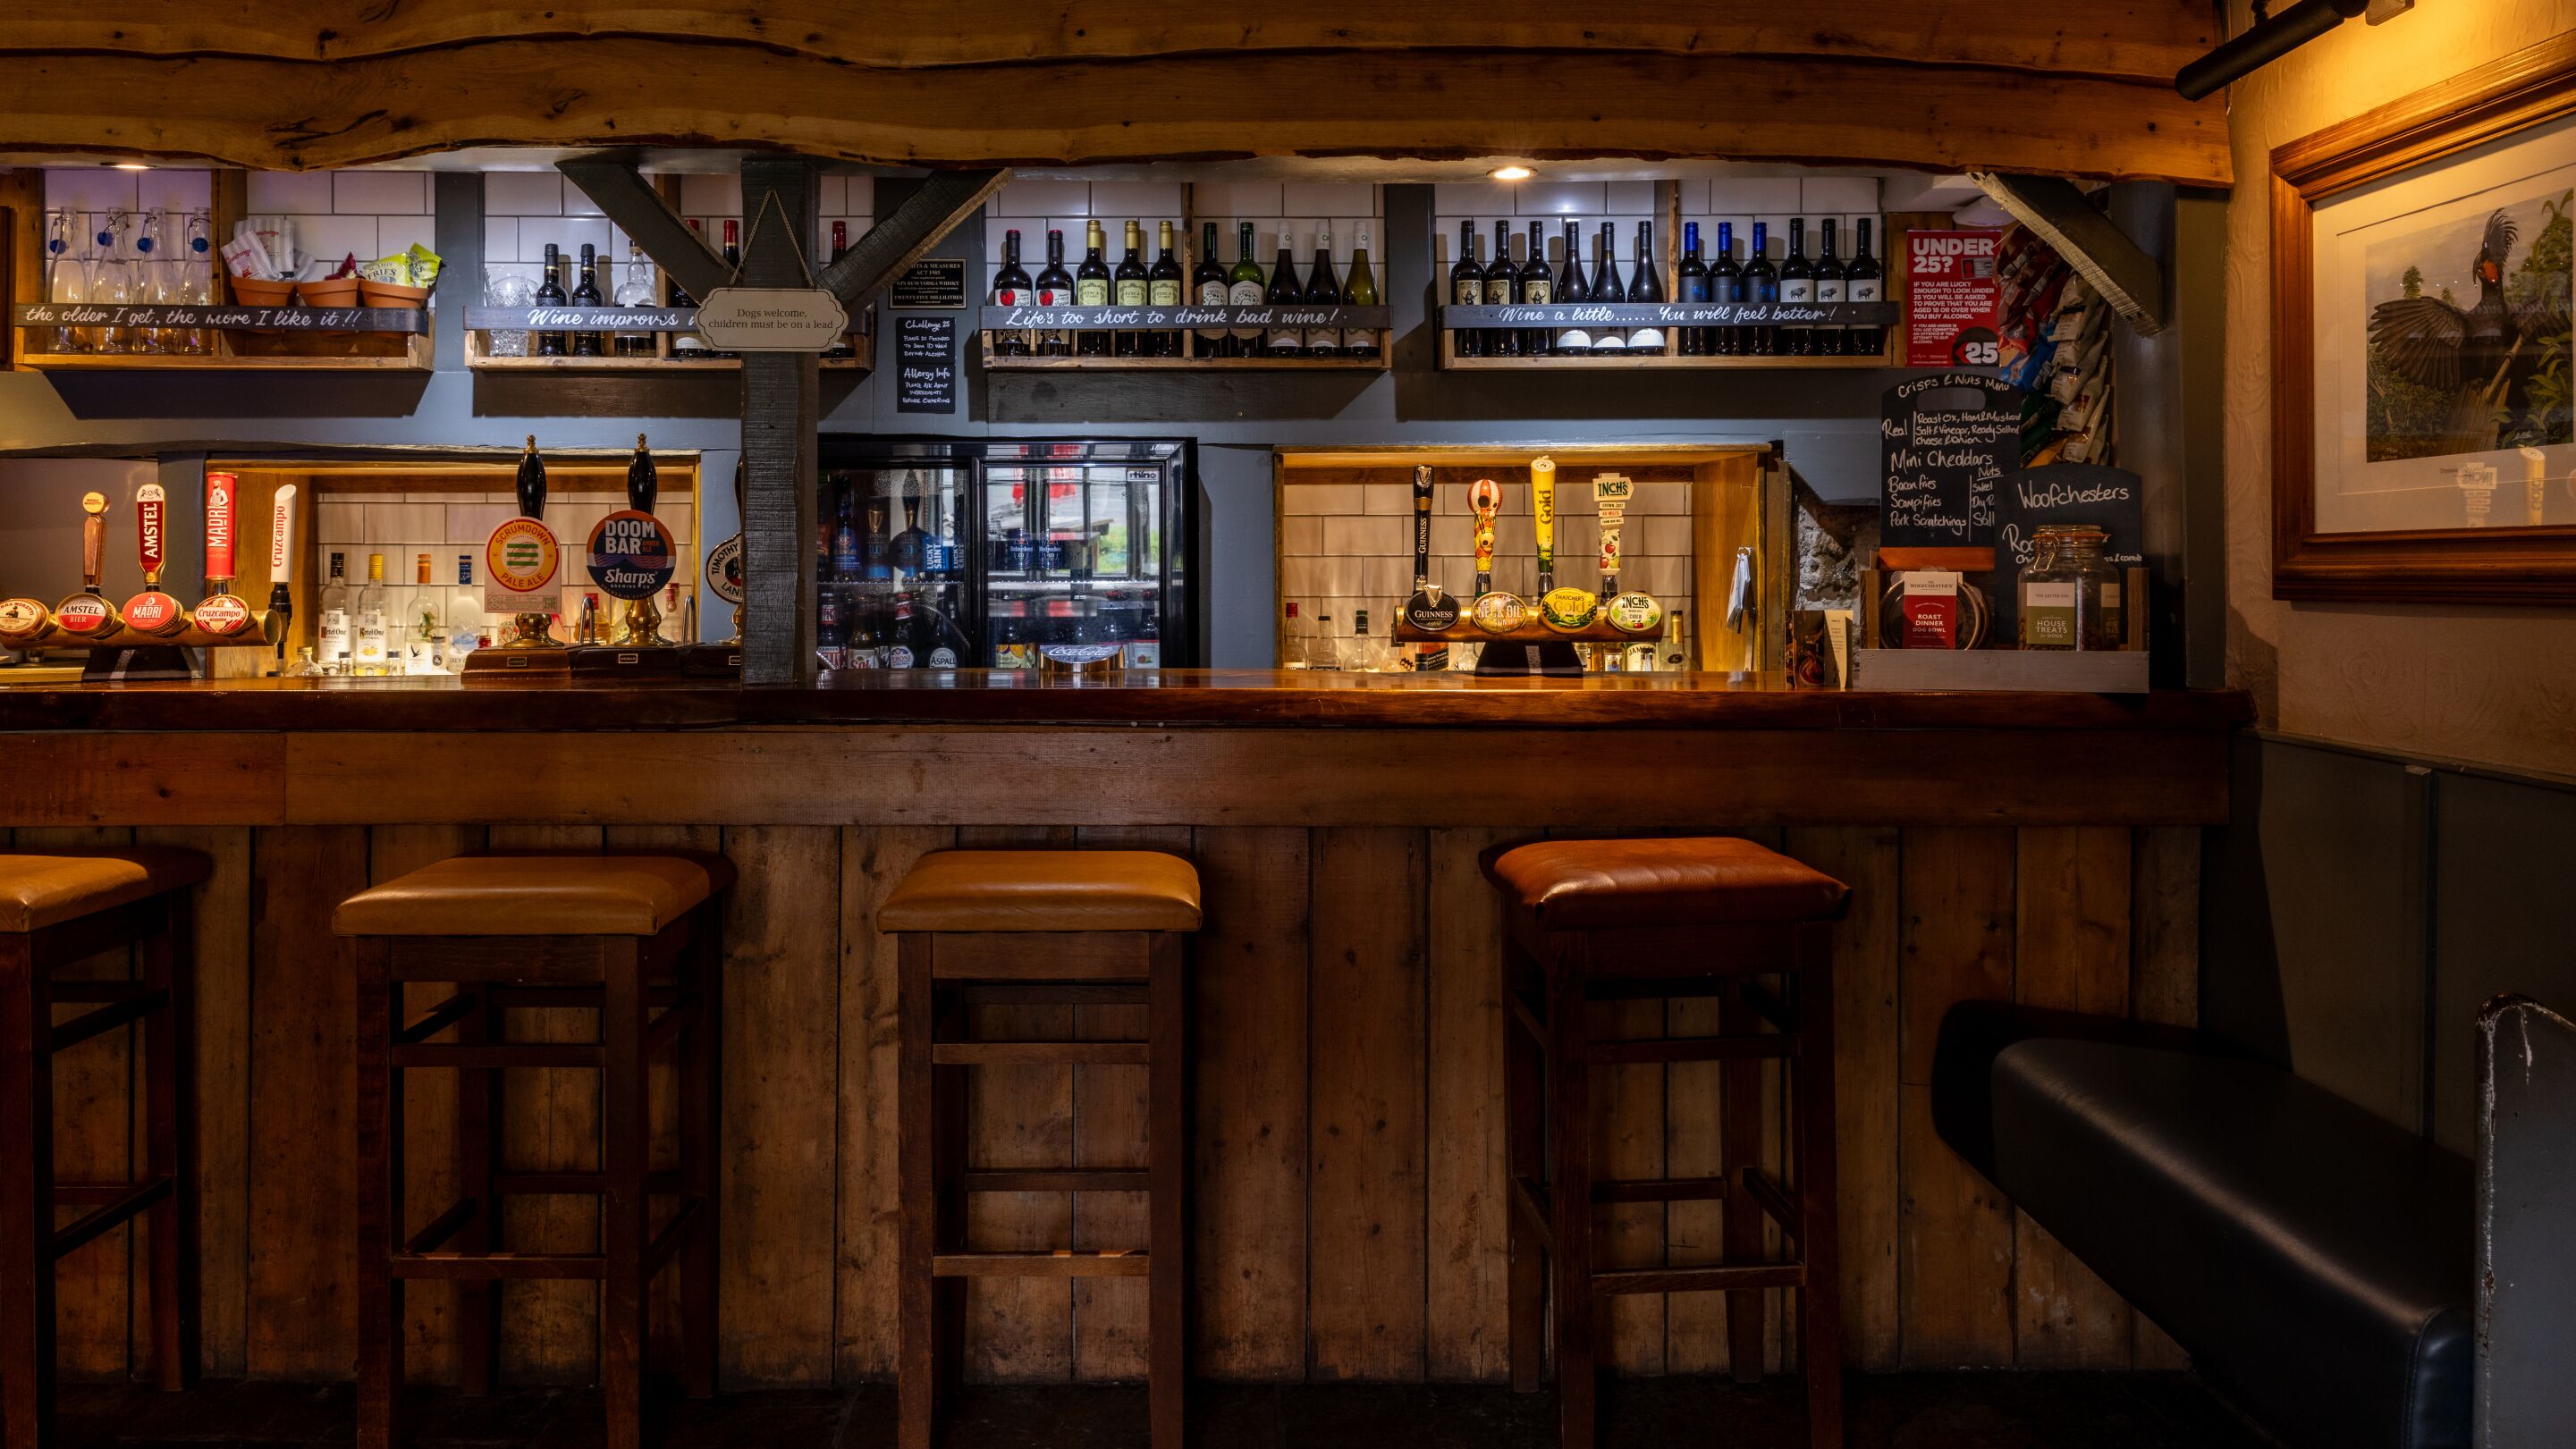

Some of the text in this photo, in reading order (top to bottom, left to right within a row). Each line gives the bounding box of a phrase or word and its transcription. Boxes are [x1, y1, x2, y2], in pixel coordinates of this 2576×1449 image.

[1913, 238, 1995, 256] UNDER
[367, 262, 393, 273] SCAMPI
[1913, 256, 1954, 274] 25?
[367, 268, 397, 280] FRIES
[26, 306, 312, 328] the older I get, the more I like
[528, 309, 584, 326] Wine
[590, 309, 680, 329] improves
[738, 308, 807, 319] Dogs welcome,
[1005, 307, 1339, 328] Life's too short to drink bad wine!
[1499, 307, 1545, 322] Wine
[1554, 312, 1565, 322] a
[1659, 306, 1685, 321] You
[1693, 306, 1730, 320] will
[1733, 306, 1768, 324] feel
[709, 319, 747, 329] children
[751, 320, 773, 329] must
[777, 319, 789, 329] be
[814, 319, 833, 329] lead
[905, 319, 950, 333] Challenge 25
[1965, 341, 1999, 364] 25
[903, 367, 950, 381] Allergy Info
[1897, 374, 2010, 397] Crisps Nuts Menu
[1917, 412, 1941, 425] Roast
[1881, 417, 1908, 441] Real
[1915, 425, 1995, 442] Salt Ready
[1890, 448, 1994, 475] Mini Cheddars
[1129, 469, 1156, 479] rhino
[1978, 467, 2002, 477] Nuts
[1598, 481, 1628, 497] INCH'S
[1888, 476, 1918, 493] Bacon
[1890, 493, 1922, 512] Scampi
[2017, 479, 2131, 510] Woofchesters
[1540, 490, 1552, 525] Gold
[143, 503, 158, 559] AMSTEL
[605, 520, 655, 538] DOOM
[1890, 510, 1967, 535] Pork Scratchings
[272, 505, 287, 568] Cruzcampo
[495, 524, 550, 545] SCRUMDOWN
[1418, 514, 1427, 553] GUINNESS
[605, 537, 642, 555] BAR
[712, 543, 739, 575] TIMOTHY
[934, 542, 943, 569] SAINT
[501, 572, 524, 587] PALE
[527, 573, 545, 586] ALE
[604, 568, 656, 588] Sharp's
[1555, 594, 1584, 602] THATCHERS
[1622, 596, 1649, 609] INCH'S
[63, 605, 99, 615] AMSTEL
[198, 609, 241, 618] Cruzcampo
[1415, 610, 1453, 619] GUINNESS
[1477, 604, 1522, 619] NECK OIL
[1553, 601, 1585, 613] Gold
[335, 628, 347, 636] One
[359, 628, 374, 636] Ketel
[932, 656, 957, 665] ASPALL
